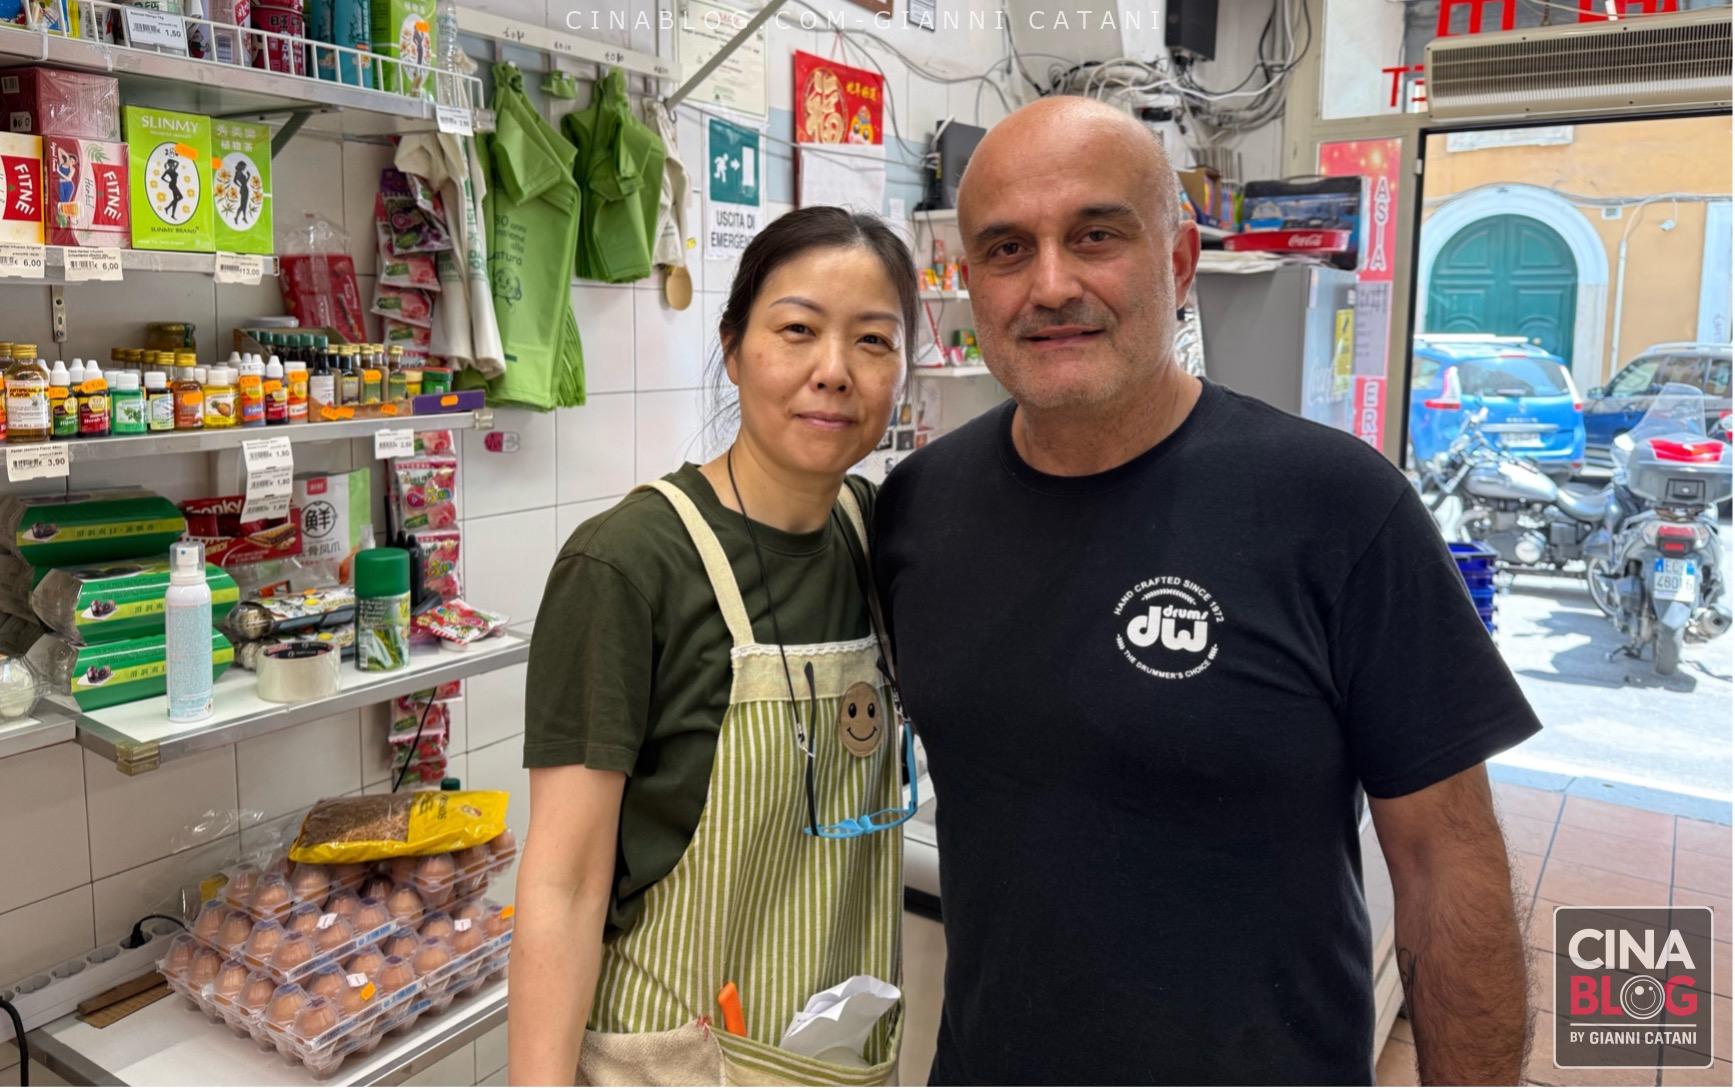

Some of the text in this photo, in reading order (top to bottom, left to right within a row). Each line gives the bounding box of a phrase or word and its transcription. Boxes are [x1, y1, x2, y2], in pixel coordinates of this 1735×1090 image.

[141, 115, 199, 132] SLINMY
[716, 210, 756, 230] USCITA DI
[1370, 176, 1390, 271] ASIA
[23, 258, 41, 268] 6,00
[102, 262, 119, 271] 6,00
[1113, 576, 1225, 623] HAND CRAFTED SINCE 1972
[1162, 604, 1209, 620] drums
[1126, 605, 1208, 653] dw
[1123, 650, 1212, 680] THE DRUMMER'S CHOICE
